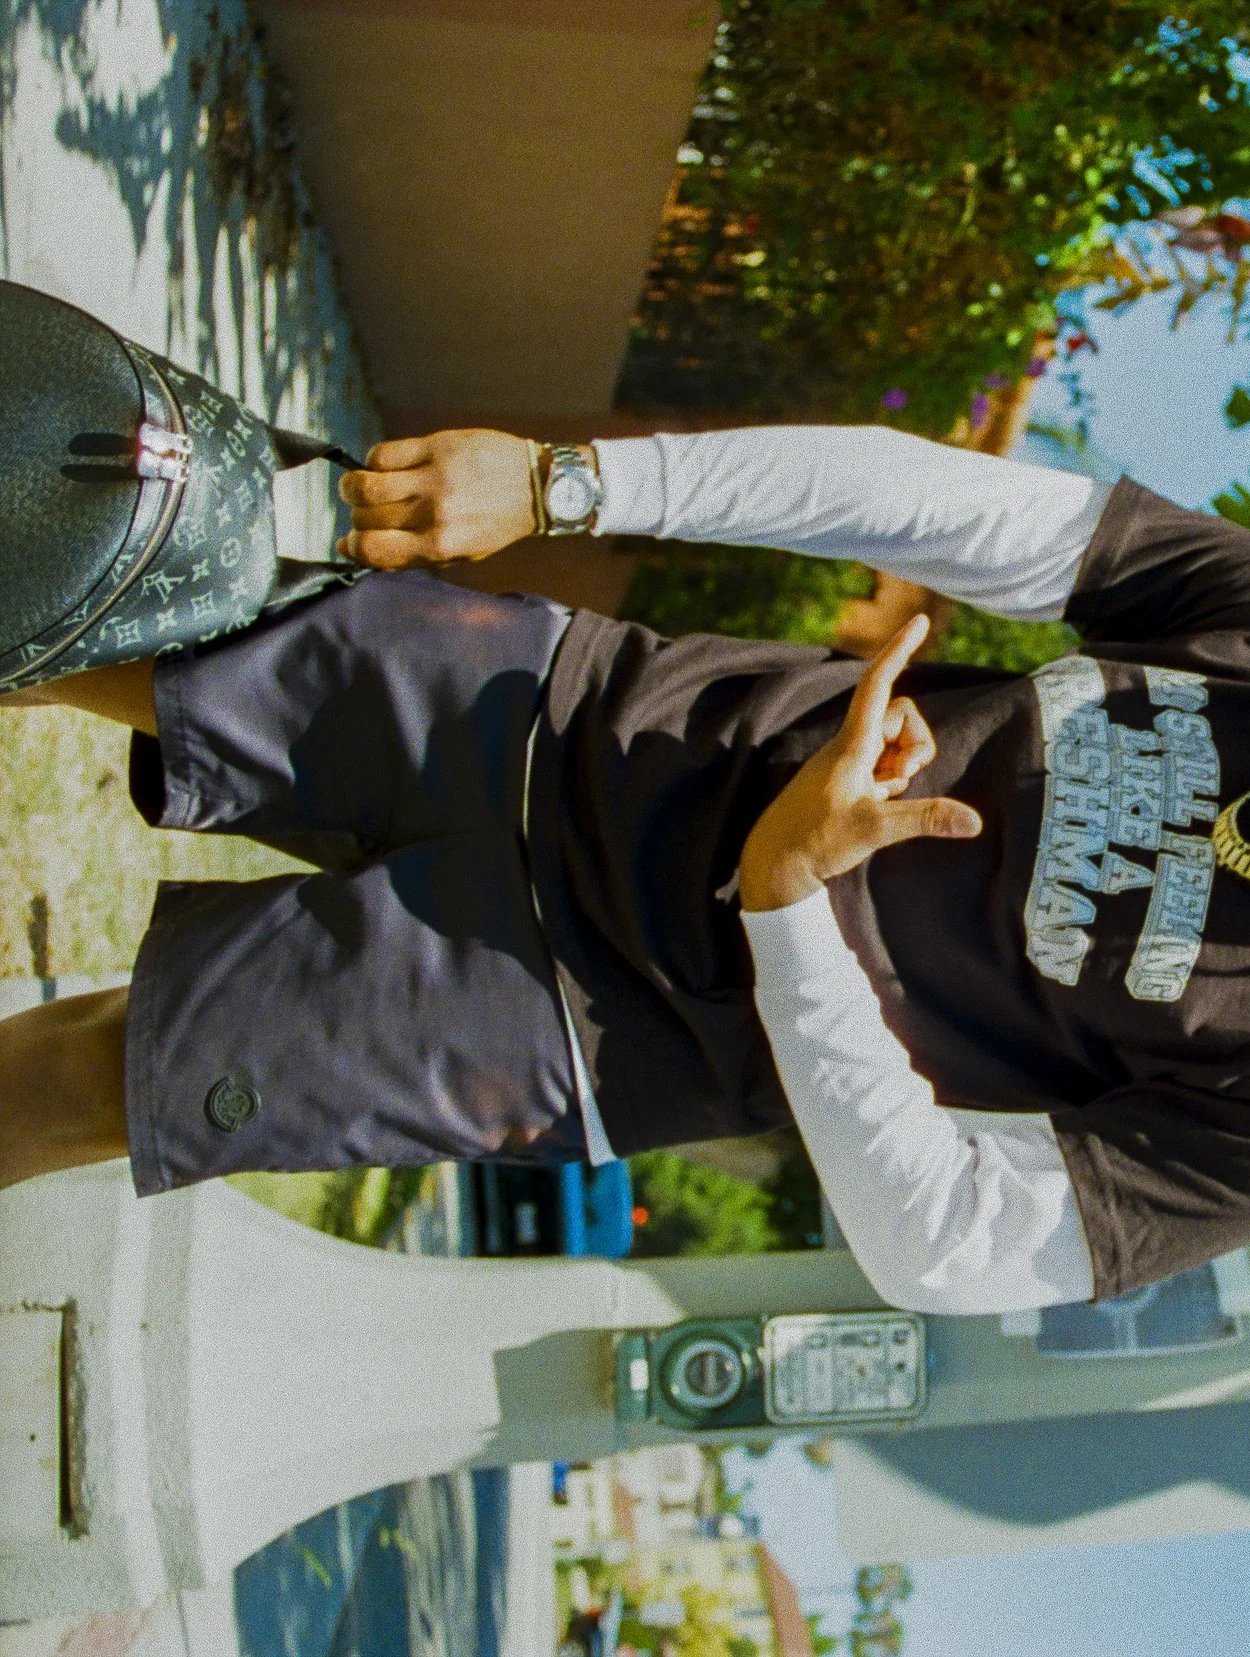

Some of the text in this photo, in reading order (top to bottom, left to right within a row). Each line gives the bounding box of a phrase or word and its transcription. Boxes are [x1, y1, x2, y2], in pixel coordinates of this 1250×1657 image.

[1024, 656, 1109, 986] RESHMAN
[1101, 724, 1165, 894] LIKE A
[1126, 832, 1215, 1002] FEELING
